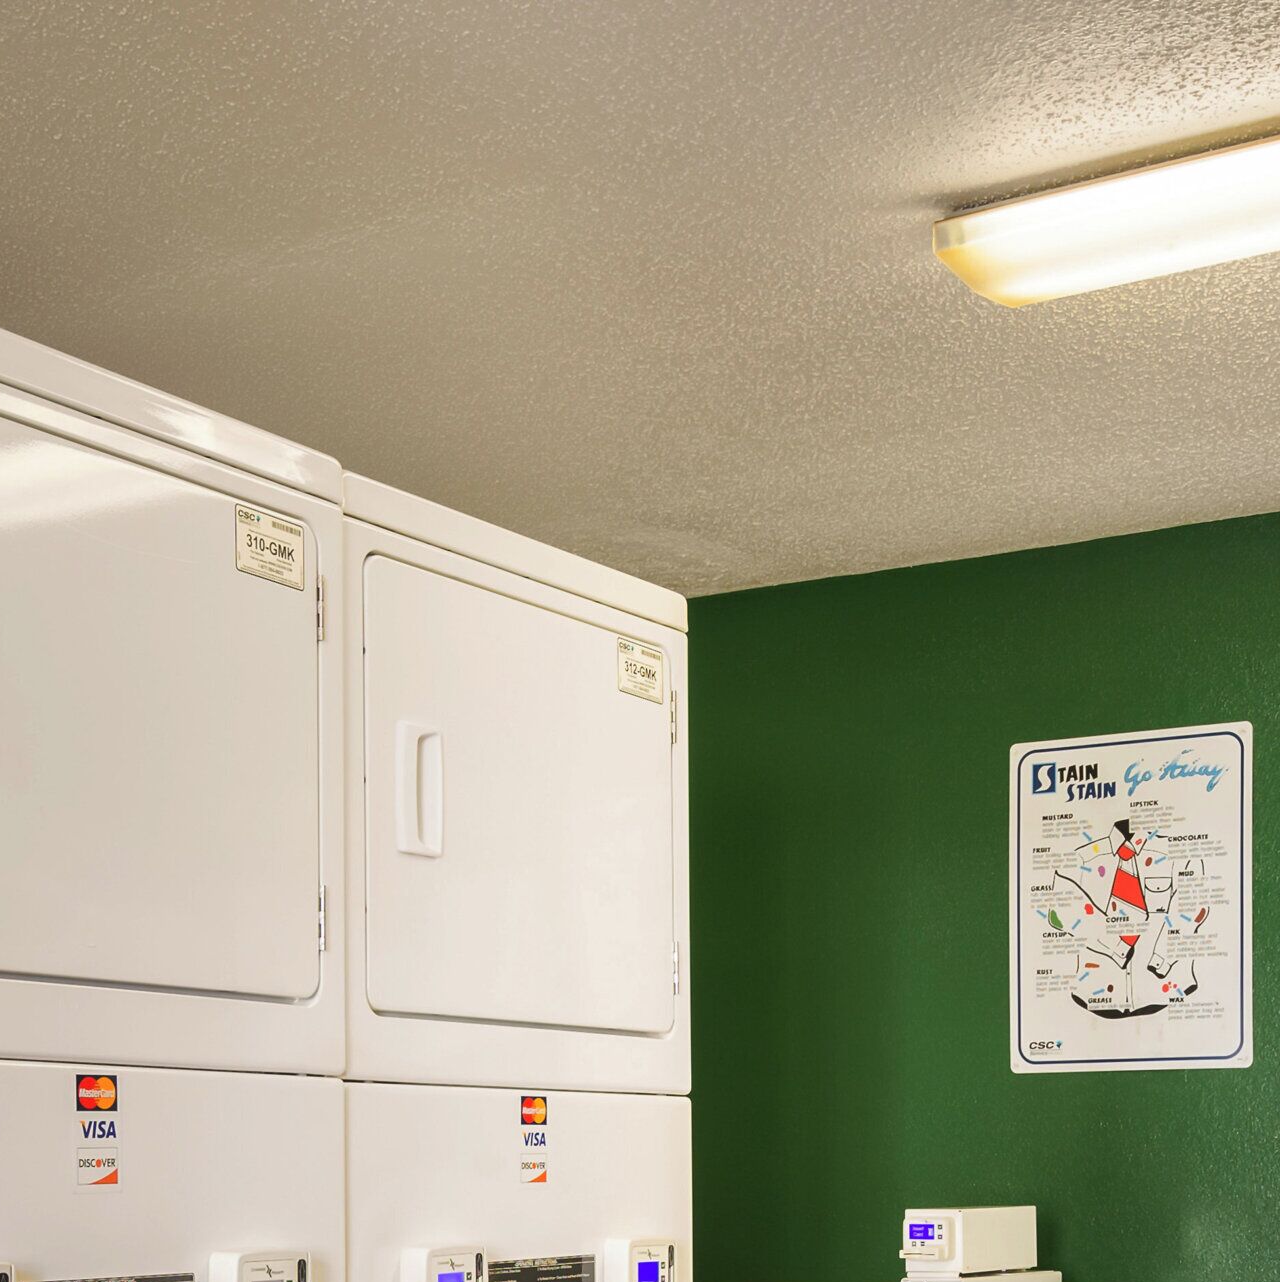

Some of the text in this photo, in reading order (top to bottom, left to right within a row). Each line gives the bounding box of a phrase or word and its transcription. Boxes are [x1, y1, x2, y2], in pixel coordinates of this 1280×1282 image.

[237, 509, 256, 521] CSC
[246, 533, 295, 562] 310-GMK
[624, 660, 657, 681] 312-GMK
[1124, 759, 1153, 796] Go
[1159, 753, 1227, 793] Away
[1066, 781, 1117, 803] STAIN
[1130, 800, 1159, 808] LIPSTICK
[1042, 813, 1074, 821] MUSTARD
[1168, 833, 1209, 842] CHOCOLATE
[1031, 884, 1053, 892] GRASS
[1029, 1041, 1055, 1050] CSC
[81, 1120, 117, 1138] VISA
[523, 1131, 546, 1146] VISA
[79, 1158, 115, 1168] DISCOVER
[521, 1162, 545, 1170] DISCOVER
